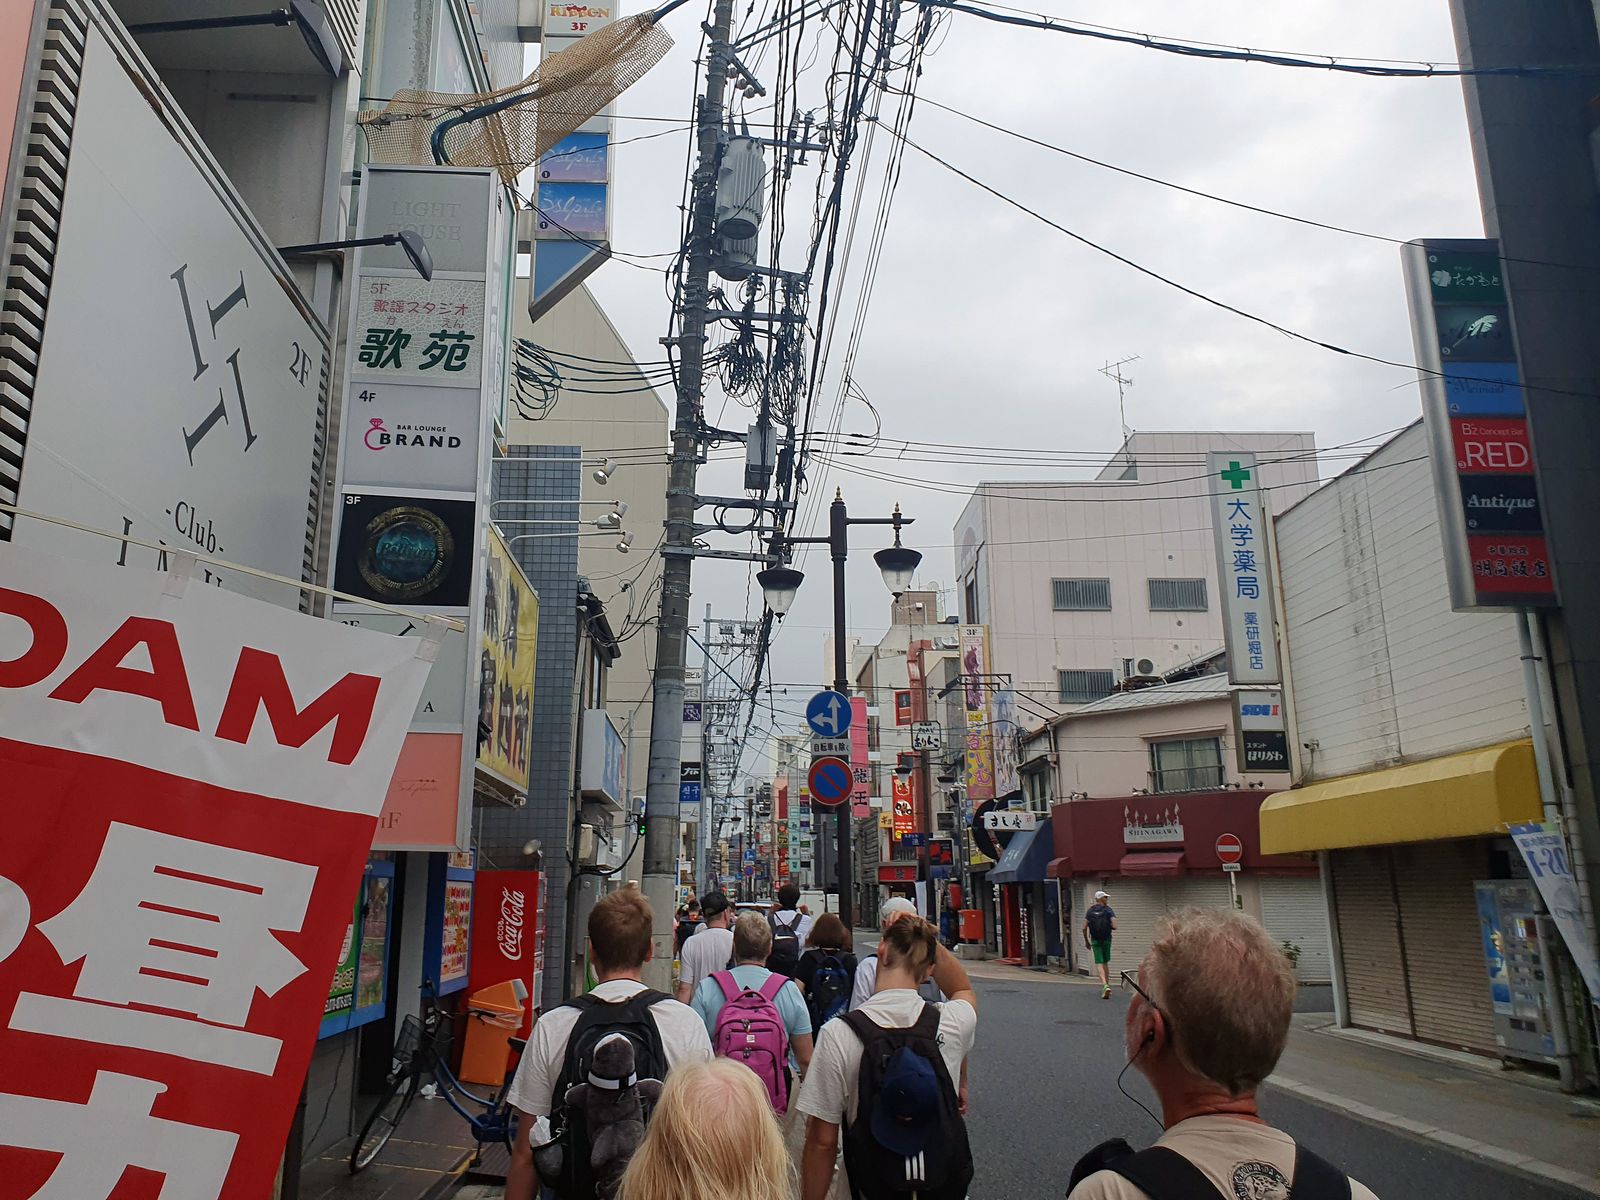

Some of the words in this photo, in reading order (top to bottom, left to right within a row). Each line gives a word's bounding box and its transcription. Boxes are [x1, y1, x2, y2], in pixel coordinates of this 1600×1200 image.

[571, 22, 588, 31] 3F
[392, 201, 461, 218] LIGHT
[370, 283, 390, 295] 5F
[373, 300, 468, 316] 歌謡スタジオ
[289, 341, 312, 388] 2F
[359, 390, 376, 402] 4F
[379, 433, 461, 448] BRAND
[1464, 441, 1529, 468] RED
[346, 496, 361, 505] 3F
[1467, 494, 1536, 515] Antique
[1227, 498, 1260, 599] 大学薬局
[1244, 612, 1264, 670] 薬研堀店
[853, 767, 868, 806] 龍王
[1128, 828, 1179, 837] SHINAGAWA
